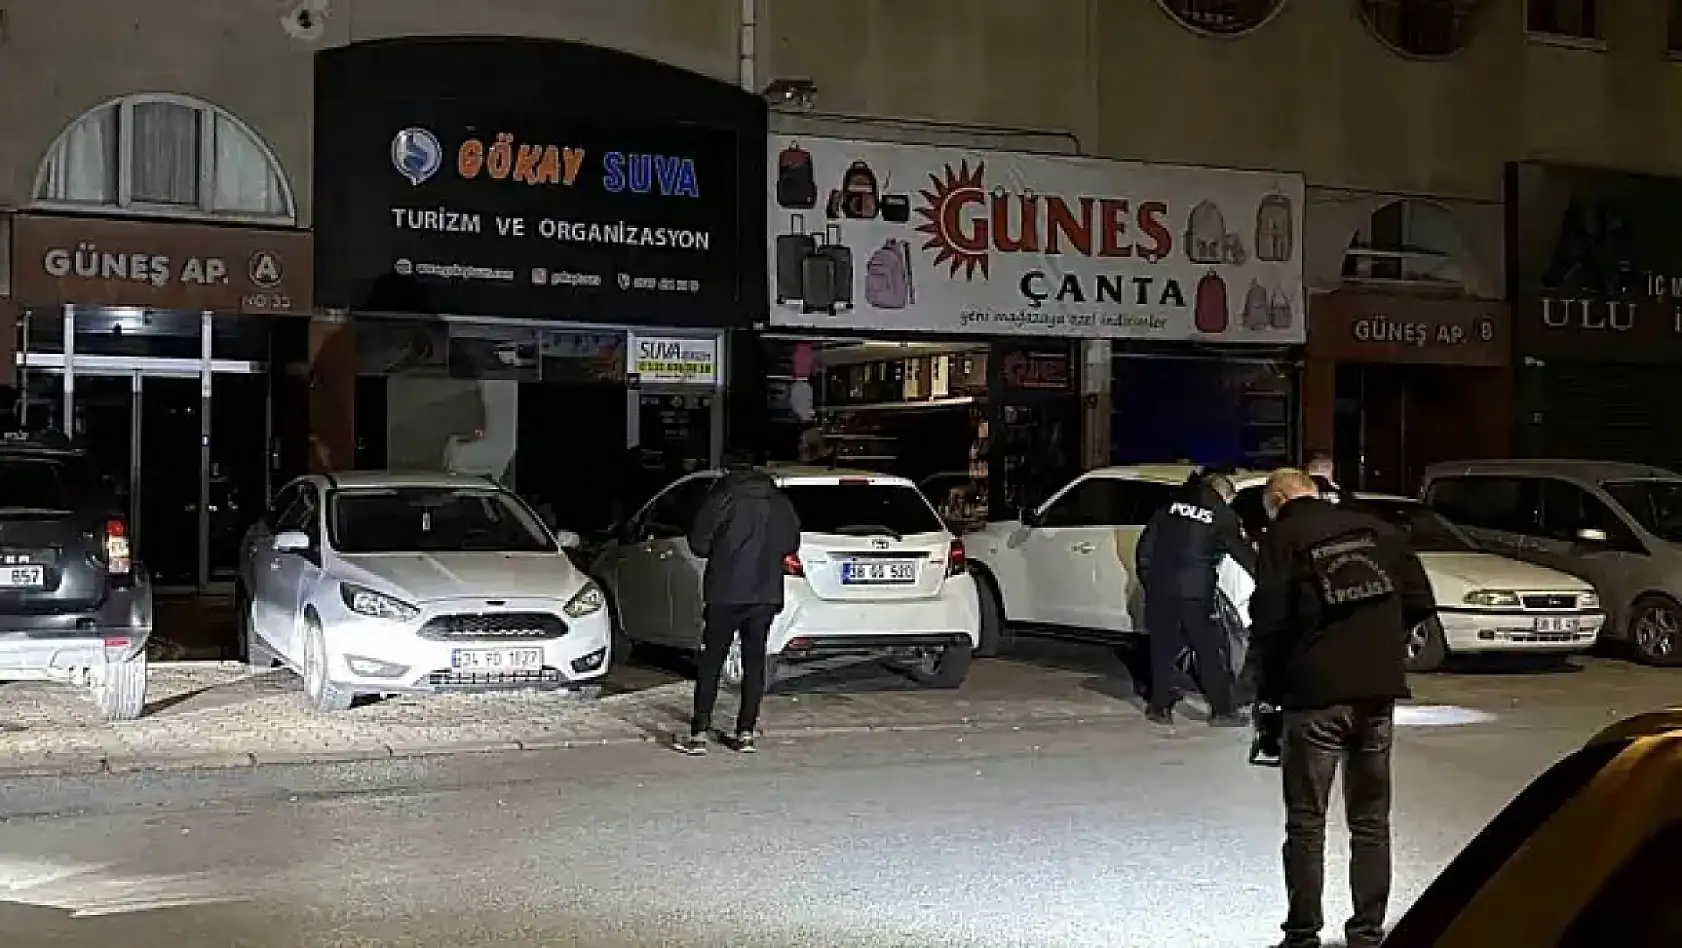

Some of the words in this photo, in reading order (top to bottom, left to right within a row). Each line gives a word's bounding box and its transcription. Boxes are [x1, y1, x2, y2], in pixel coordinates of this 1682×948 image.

[458, 132, 586, 186] GÖKAY
[603, 151, 700, 198] SUVA
[391, 205, 481, 233] TURİZM
[496, 216, 525, 237] VE
[538, 218, 709, 250] ORGANİZASYON
[941, 184, 1172, 265] GÜNEŞ
[44, 241, 171, 286] GÜNEŞ
[181, 258, 229, 285] AP.
[254, 256, 279, 281] A
[1020, 270, 1186, 308] ÇANTA
[1354, 315, 1427, 347] GÜNEŞ
[1543, 299, 1637, 331] ULU
